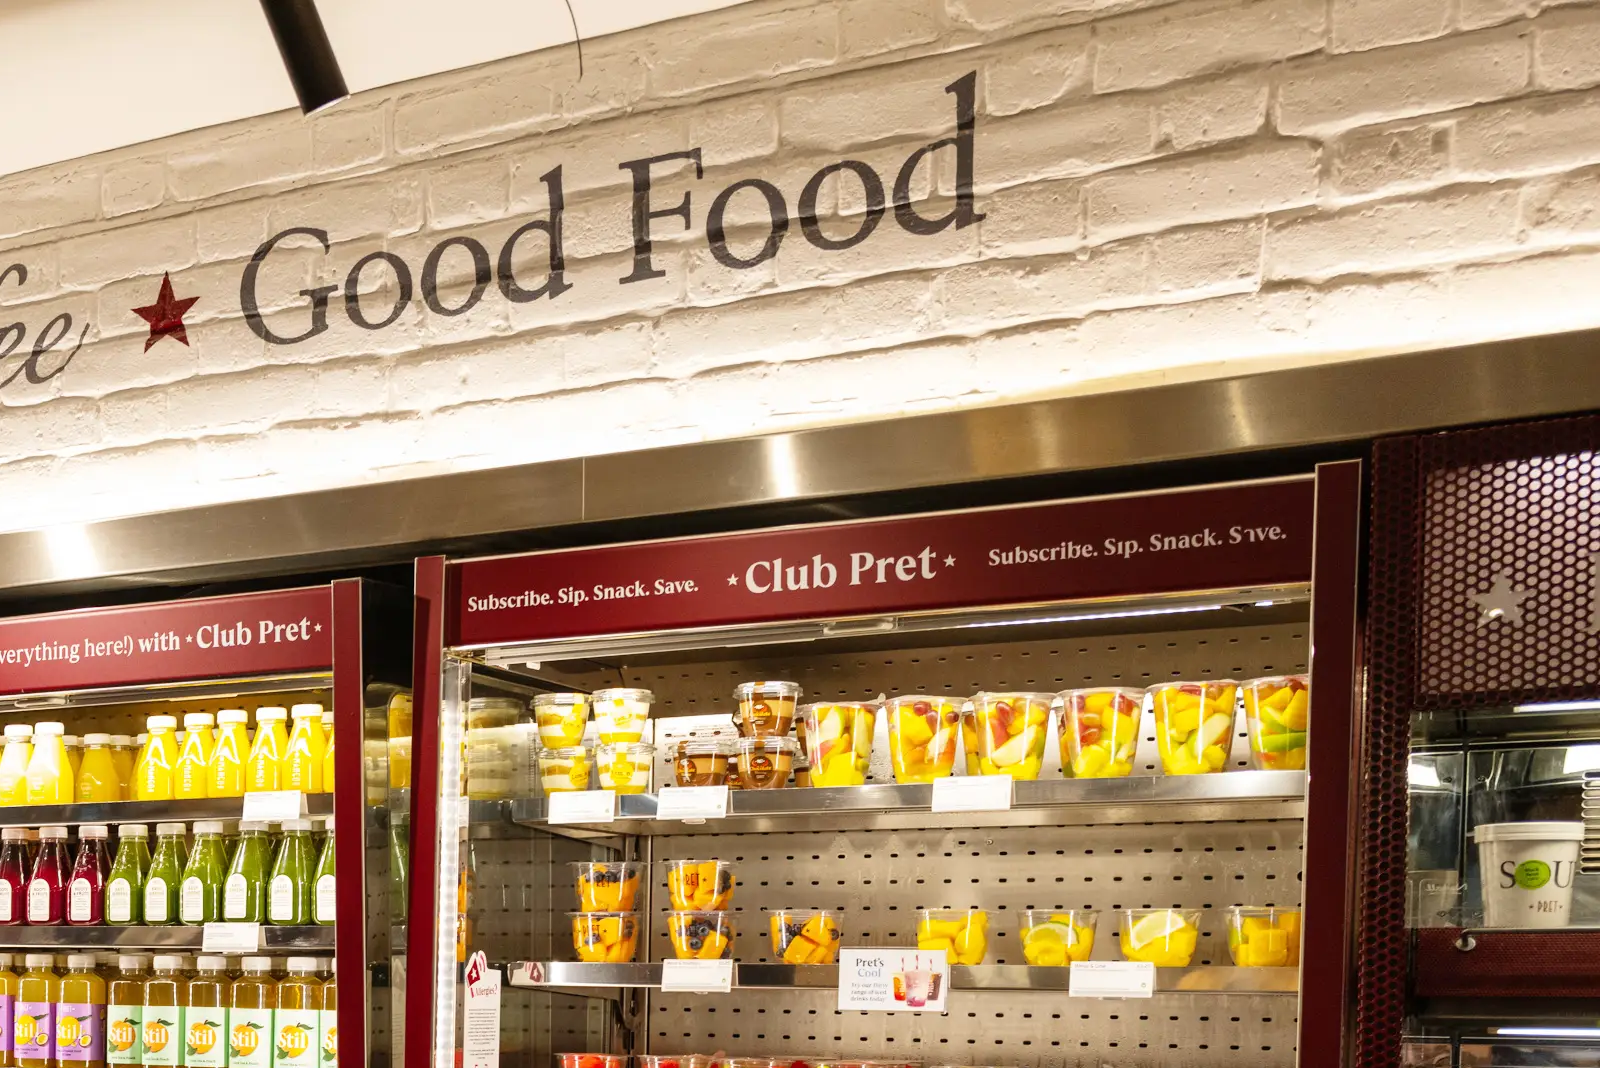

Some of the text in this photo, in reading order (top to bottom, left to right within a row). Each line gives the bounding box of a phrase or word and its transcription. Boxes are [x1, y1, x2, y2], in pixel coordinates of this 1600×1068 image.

[239, 70, 987, 345] Good Food
[988, 541, 1098, 566] Subscribe.
[1149, 529, 1223, 552] Snack.
[745, 545, 937, 593] Club Pret
[468, 578, 699, 612] Subscribe. Sip. Snack. Save.
[84, 636, 134, 659] here!)
[138, 632, 180, 653] with
[196, 616, 311, 649] Club Pret
[1537, 900, 1558, 912] PRET
[856, 958, 884, 967] Pret's
[858, 969, 880, 977] Cool
[475, 983, 498, 997] Allergies?
